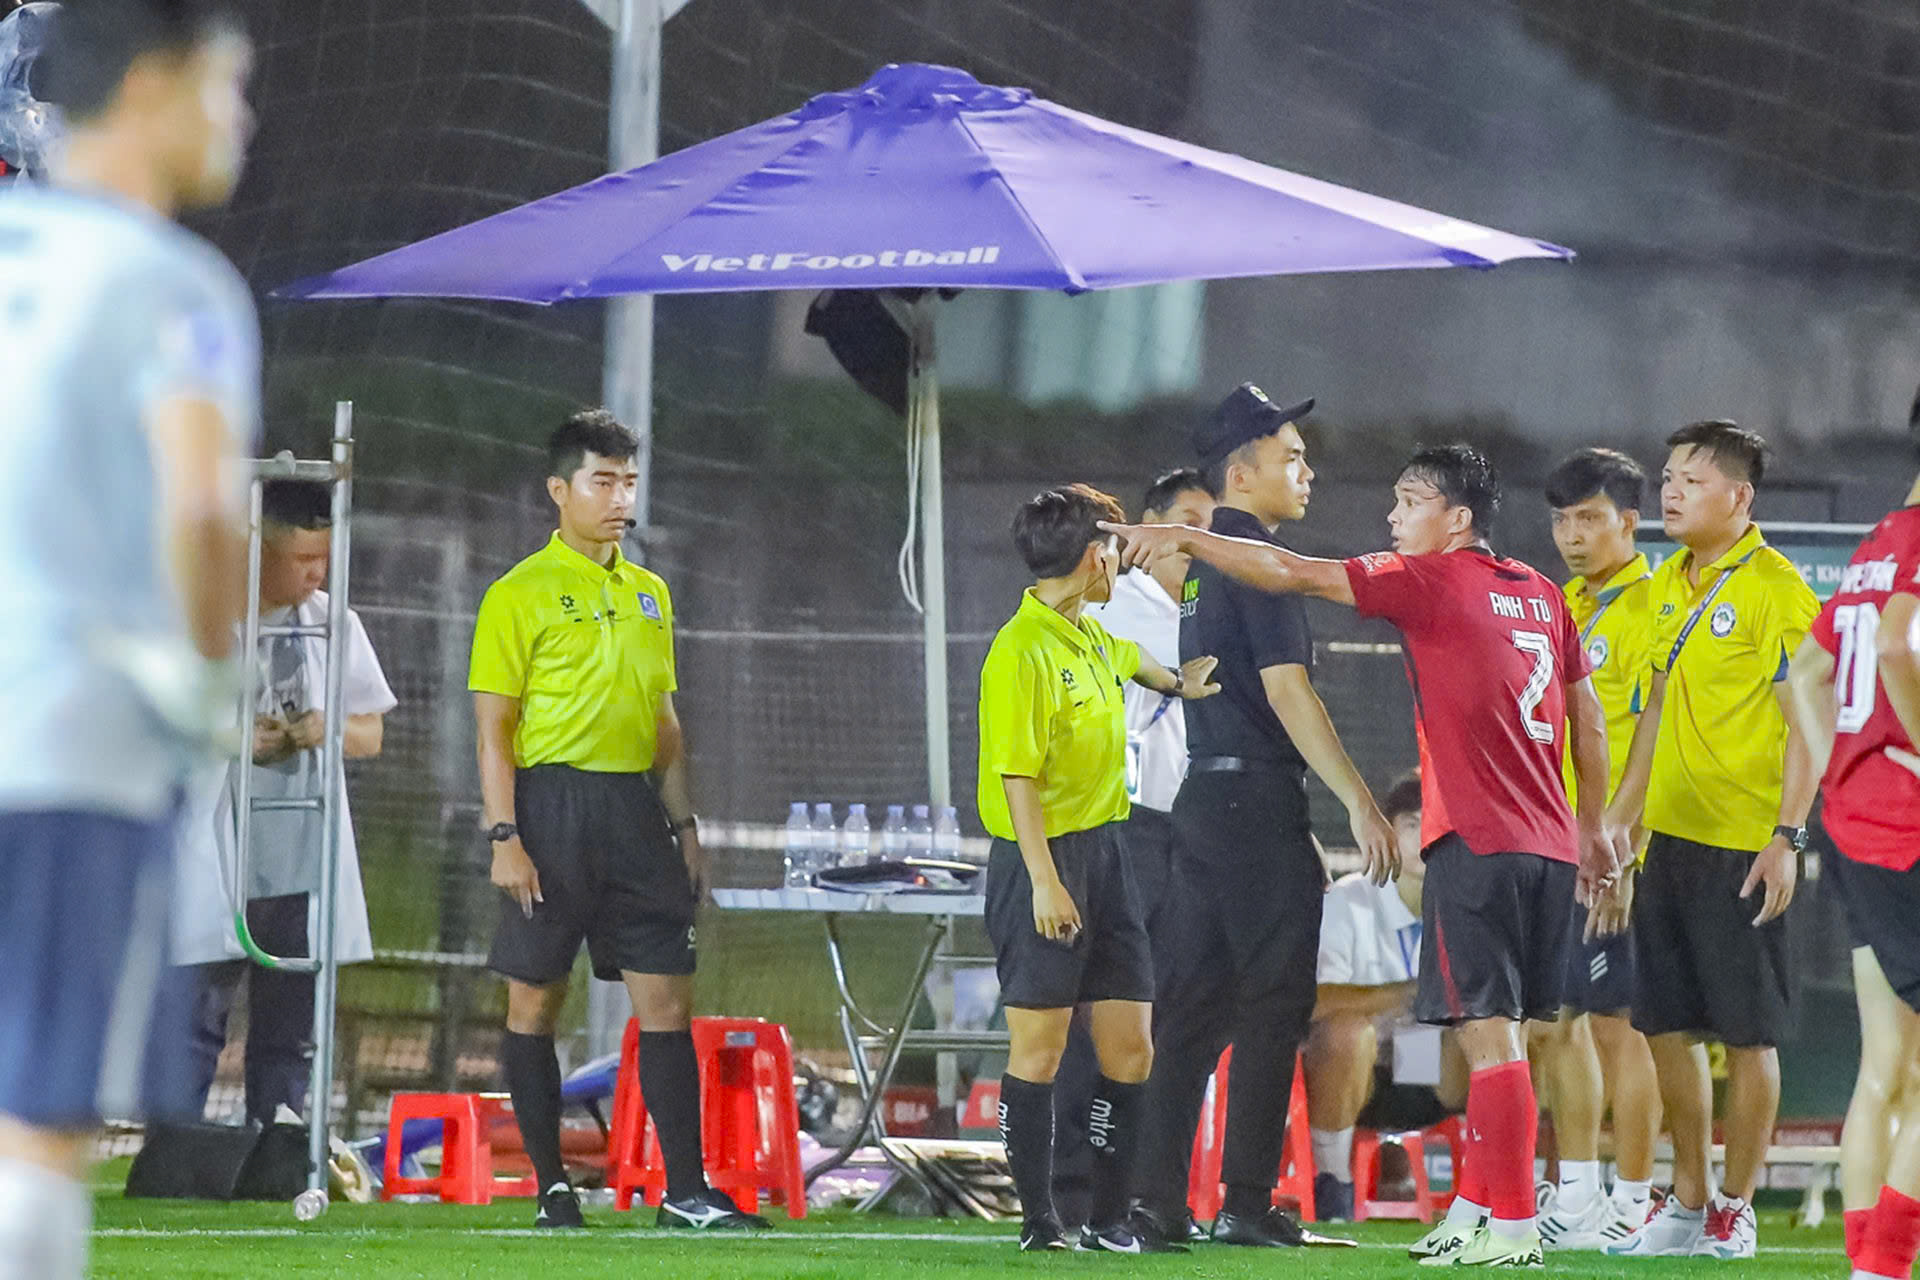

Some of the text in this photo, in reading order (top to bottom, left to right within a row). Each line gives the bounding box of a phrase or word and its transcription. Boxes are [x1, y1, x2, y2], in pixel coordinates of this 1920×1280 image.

[660, 246, 1000, 272] VietFootball
[1488, 591, 1553, 623] ANH TÚ
[1511, 629, 1555, 745] 2
[1089, 1098, 1116, 1148] mitre
